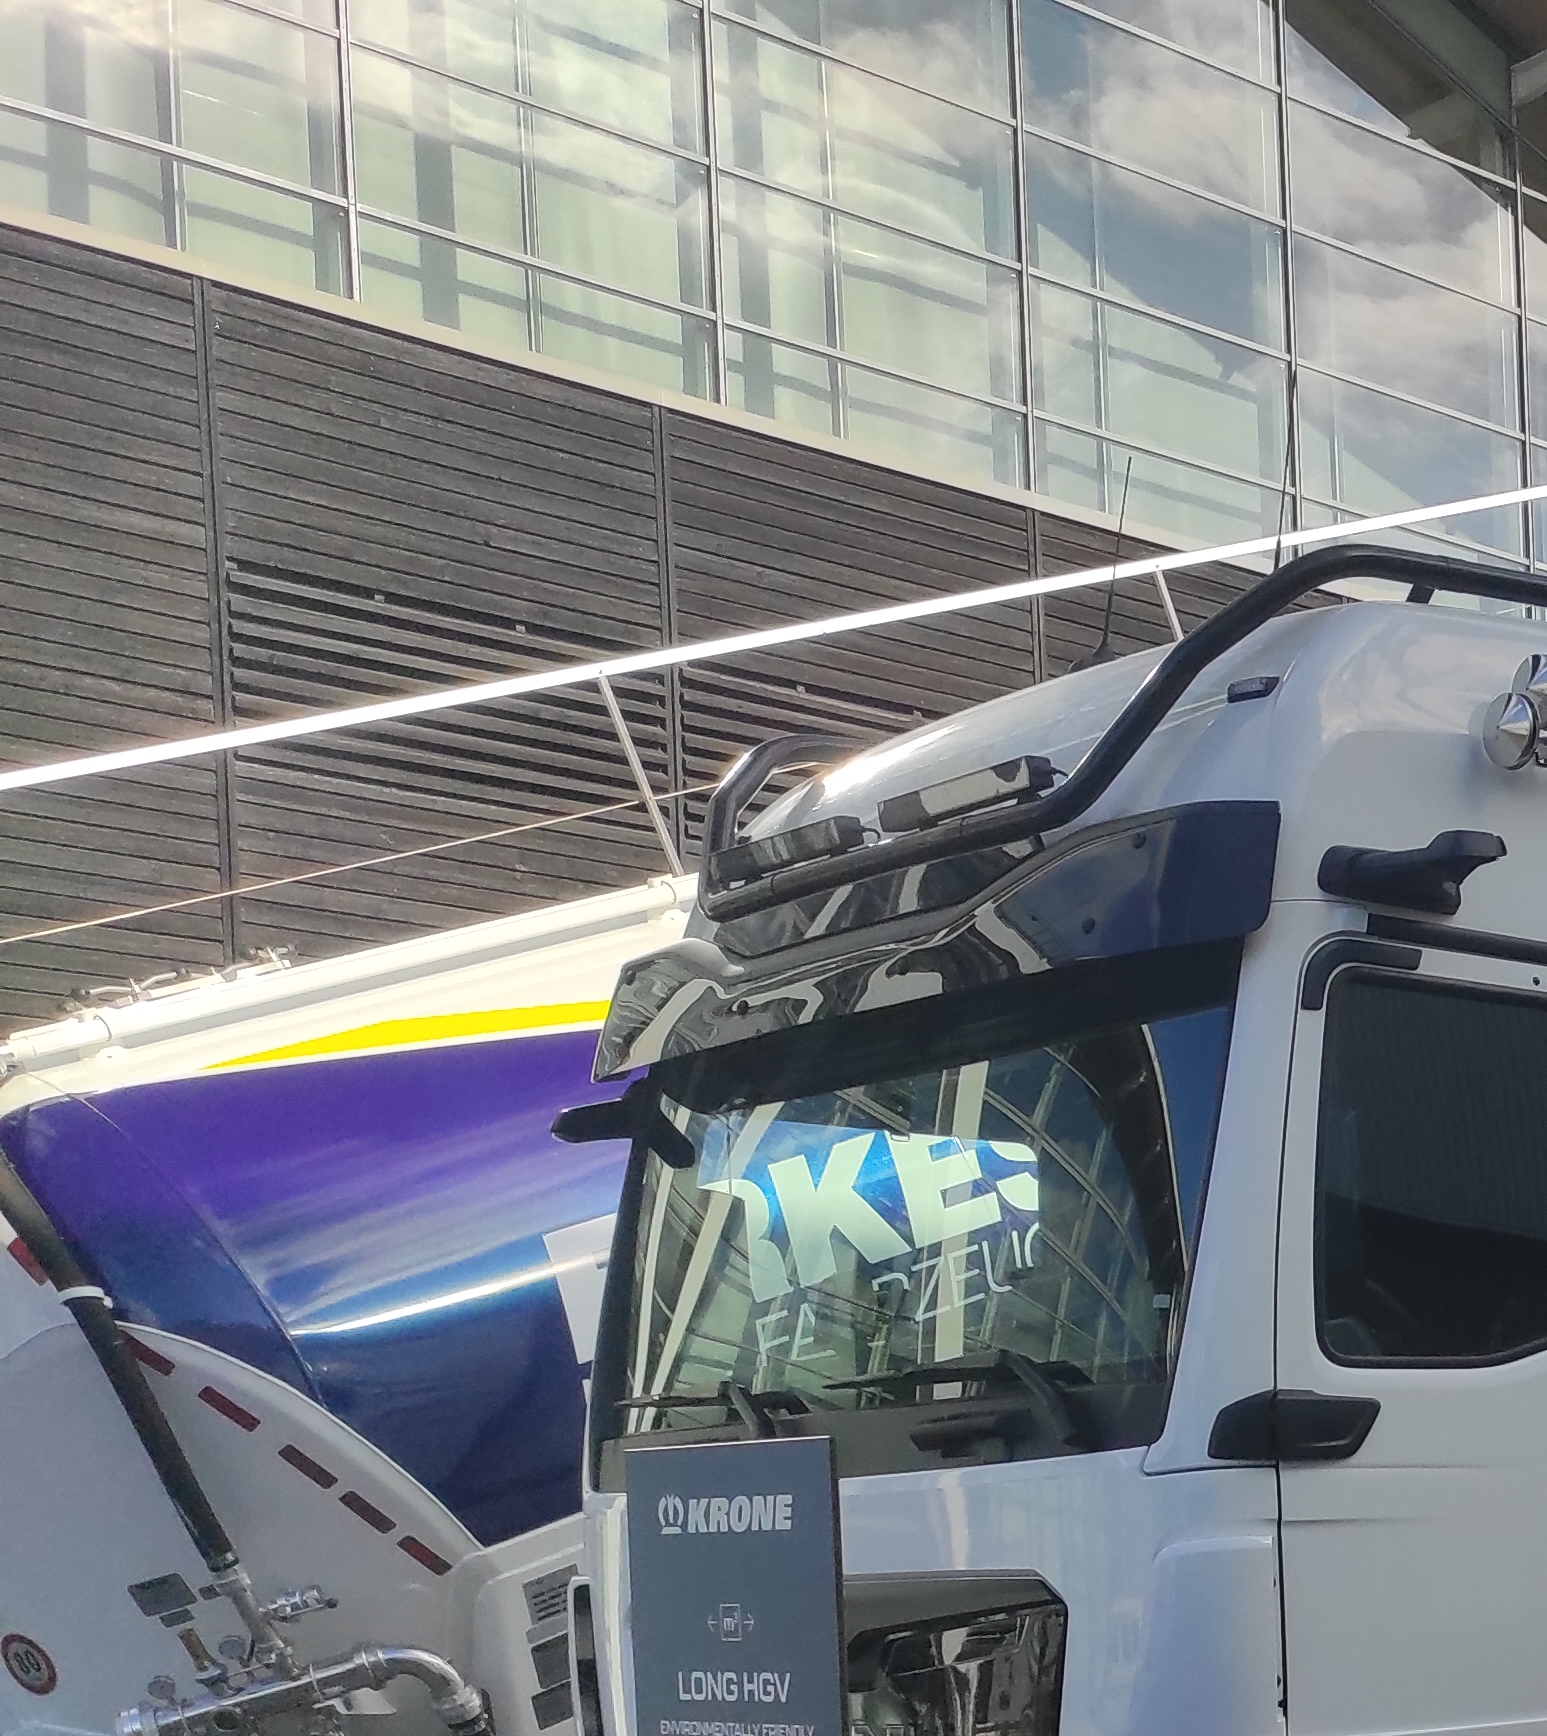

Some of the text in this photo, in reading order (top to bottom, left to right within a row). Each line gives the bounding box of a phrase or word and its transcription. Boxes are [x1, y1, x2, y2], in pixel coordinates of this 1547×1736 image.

[688, 1494, 793, 1534] KRONE
[678, 1671, 791, 1703] LONG HGV
